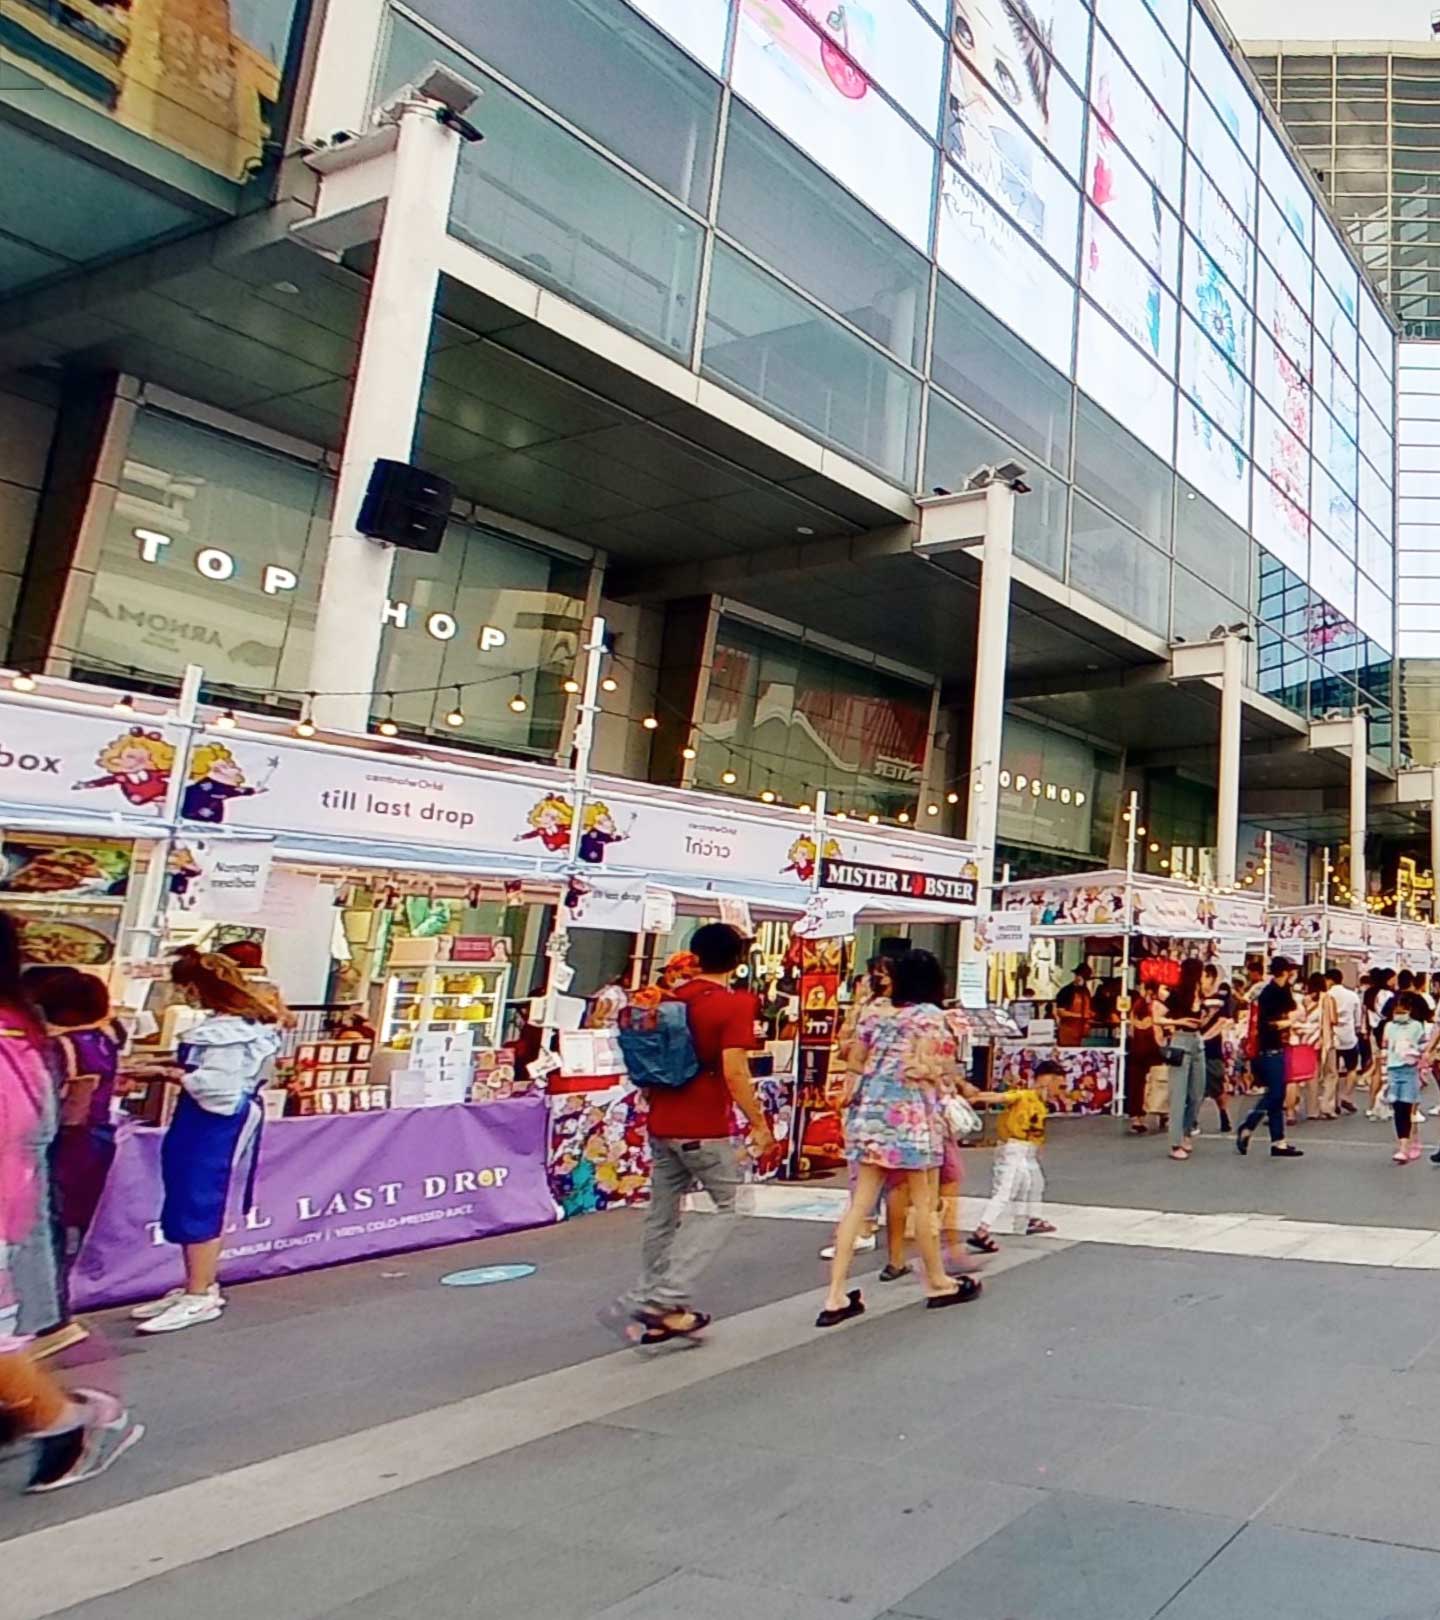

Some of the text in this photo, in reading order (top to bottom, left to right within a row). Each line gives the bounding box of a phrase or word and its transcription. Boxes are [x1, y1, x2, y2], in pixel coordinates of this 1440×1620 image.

[1000, 770, 1086, 807] OPSHOP
[321, 789, 475, 829] till last drop
[826, 863, 898, 893] MISTER
[145, 1167, 510, 1247] TL LAST DROP
